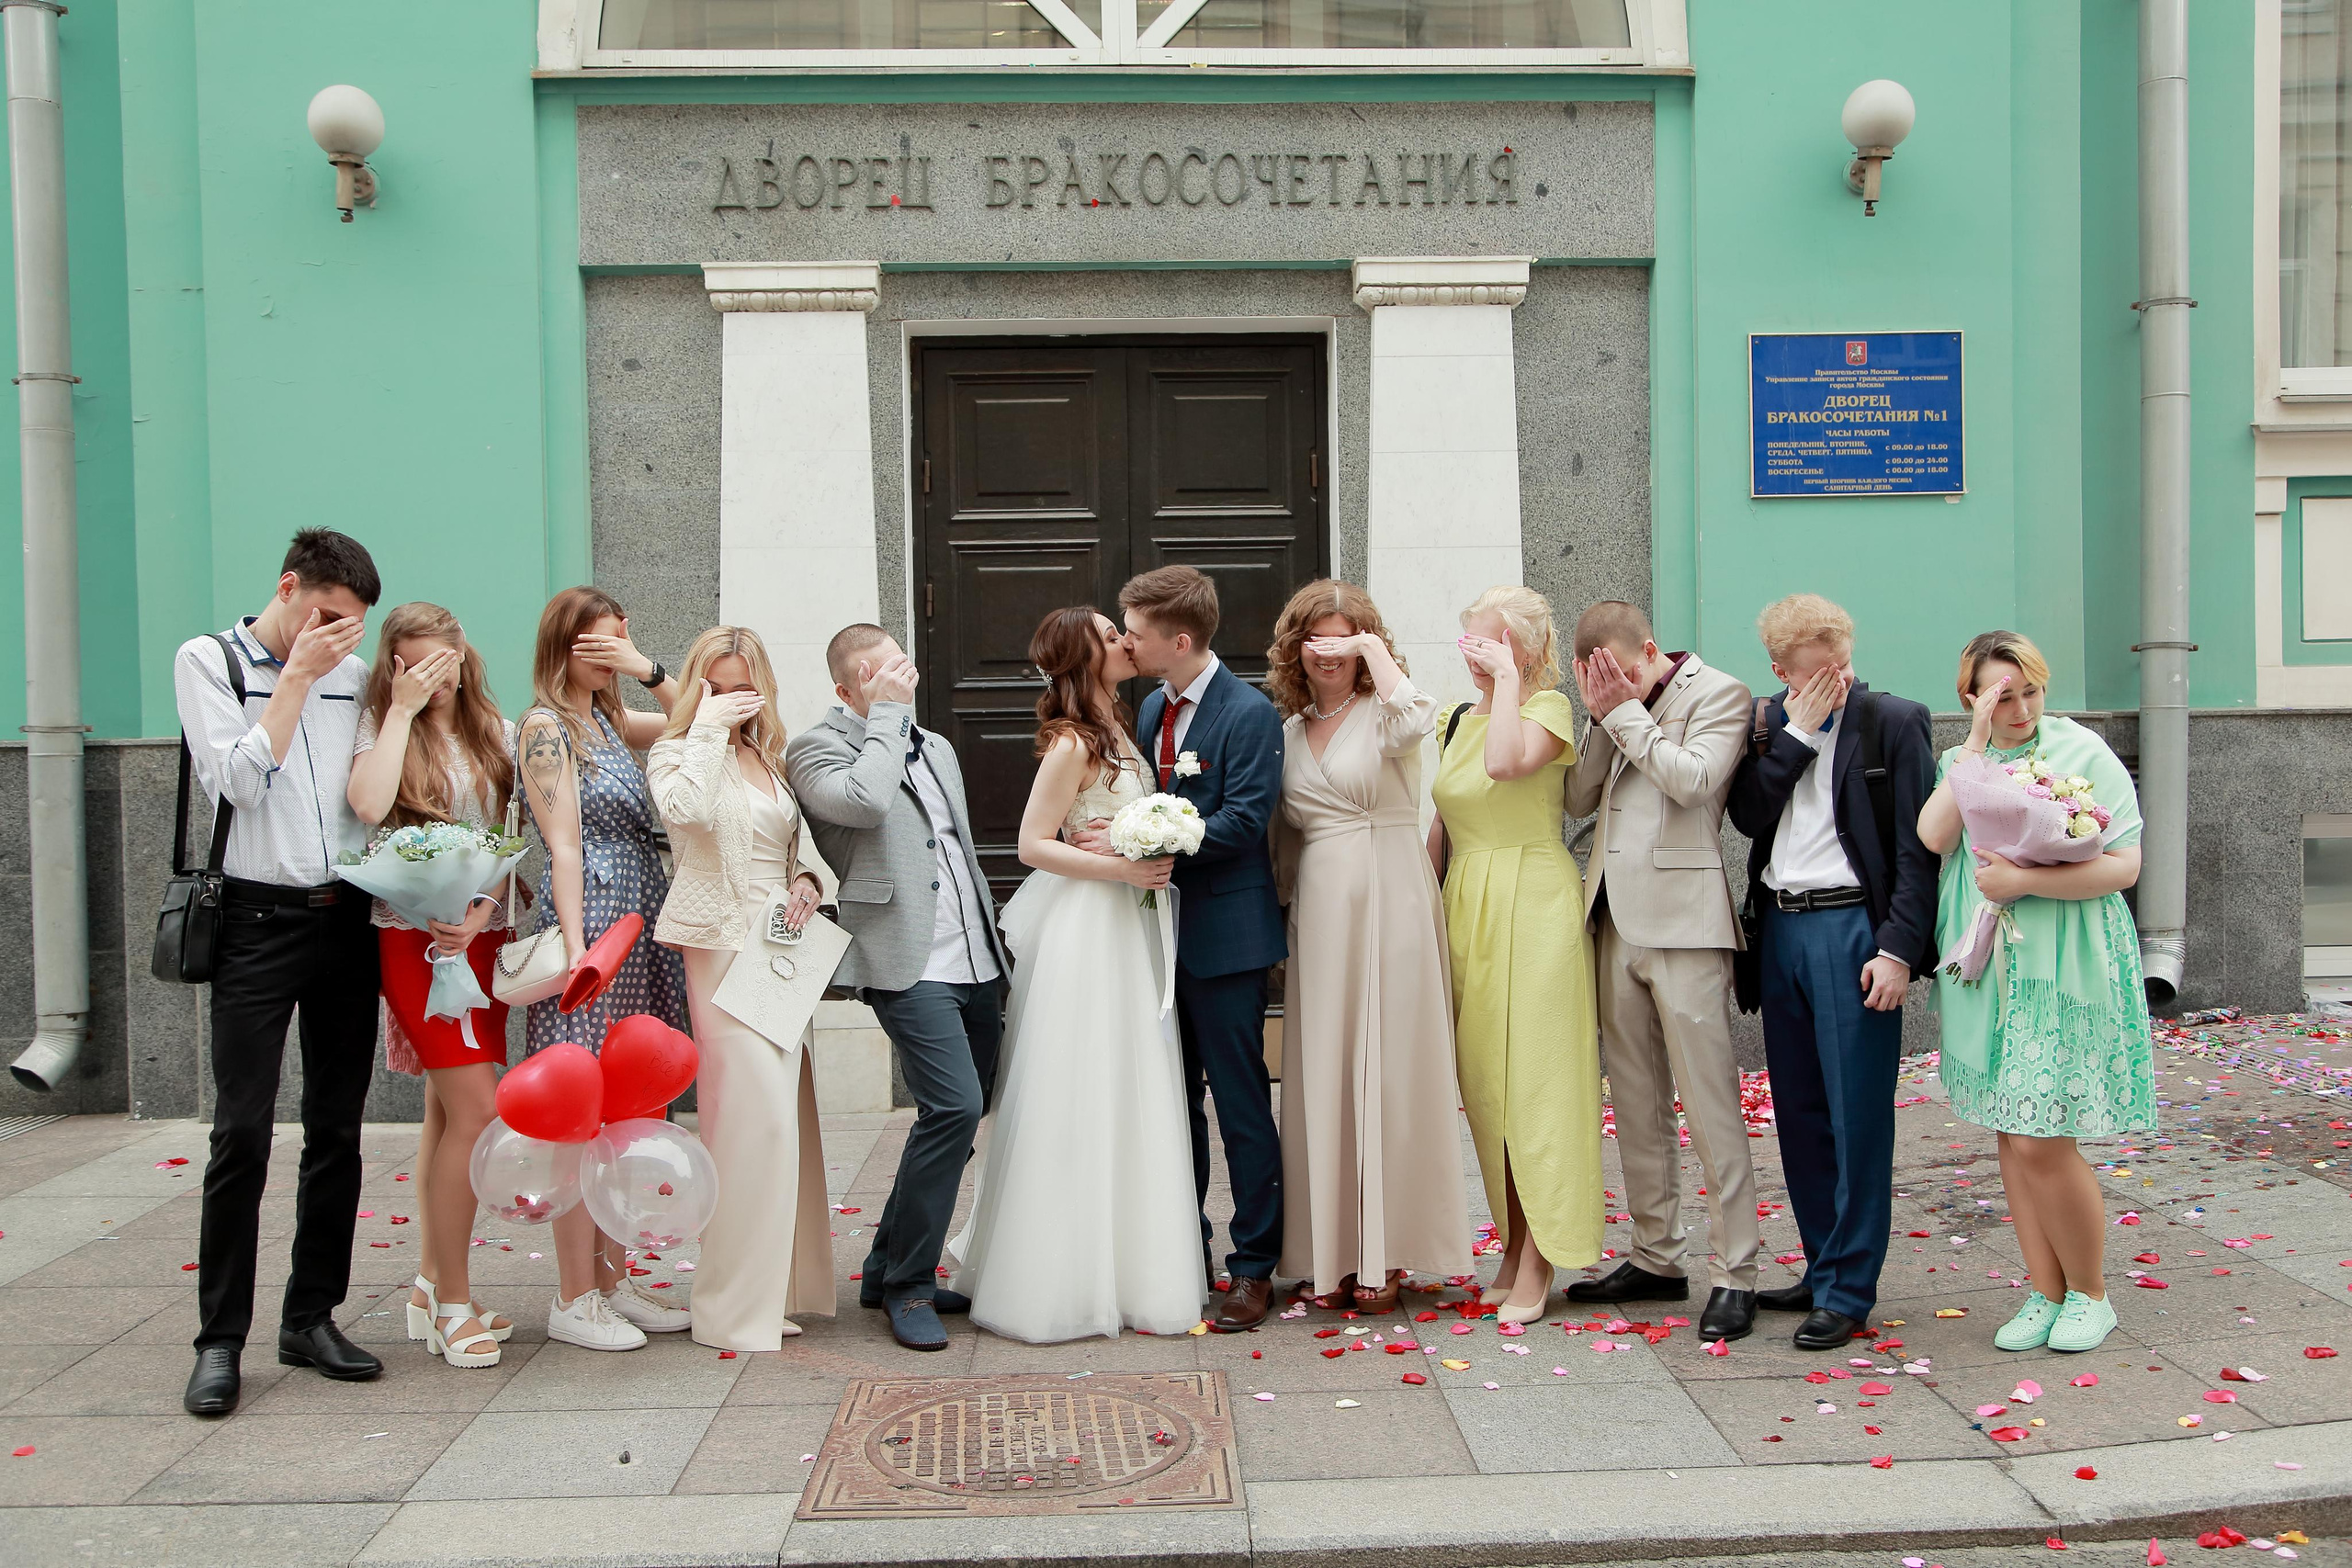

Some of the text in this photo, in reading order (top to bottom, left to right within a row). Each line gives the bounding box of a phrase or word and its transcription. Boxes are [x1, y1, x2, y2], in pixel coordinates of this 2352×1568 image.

[711, 151, 1519, 213] ДВОРЕЦ БРАКОСОЧЕТАНИЯ
[1824, 395, 1891, 410] ДВОРЕЦ
[1768, 410, 1947, 423] БРАКОСОЧЕТАНИЯ №1
